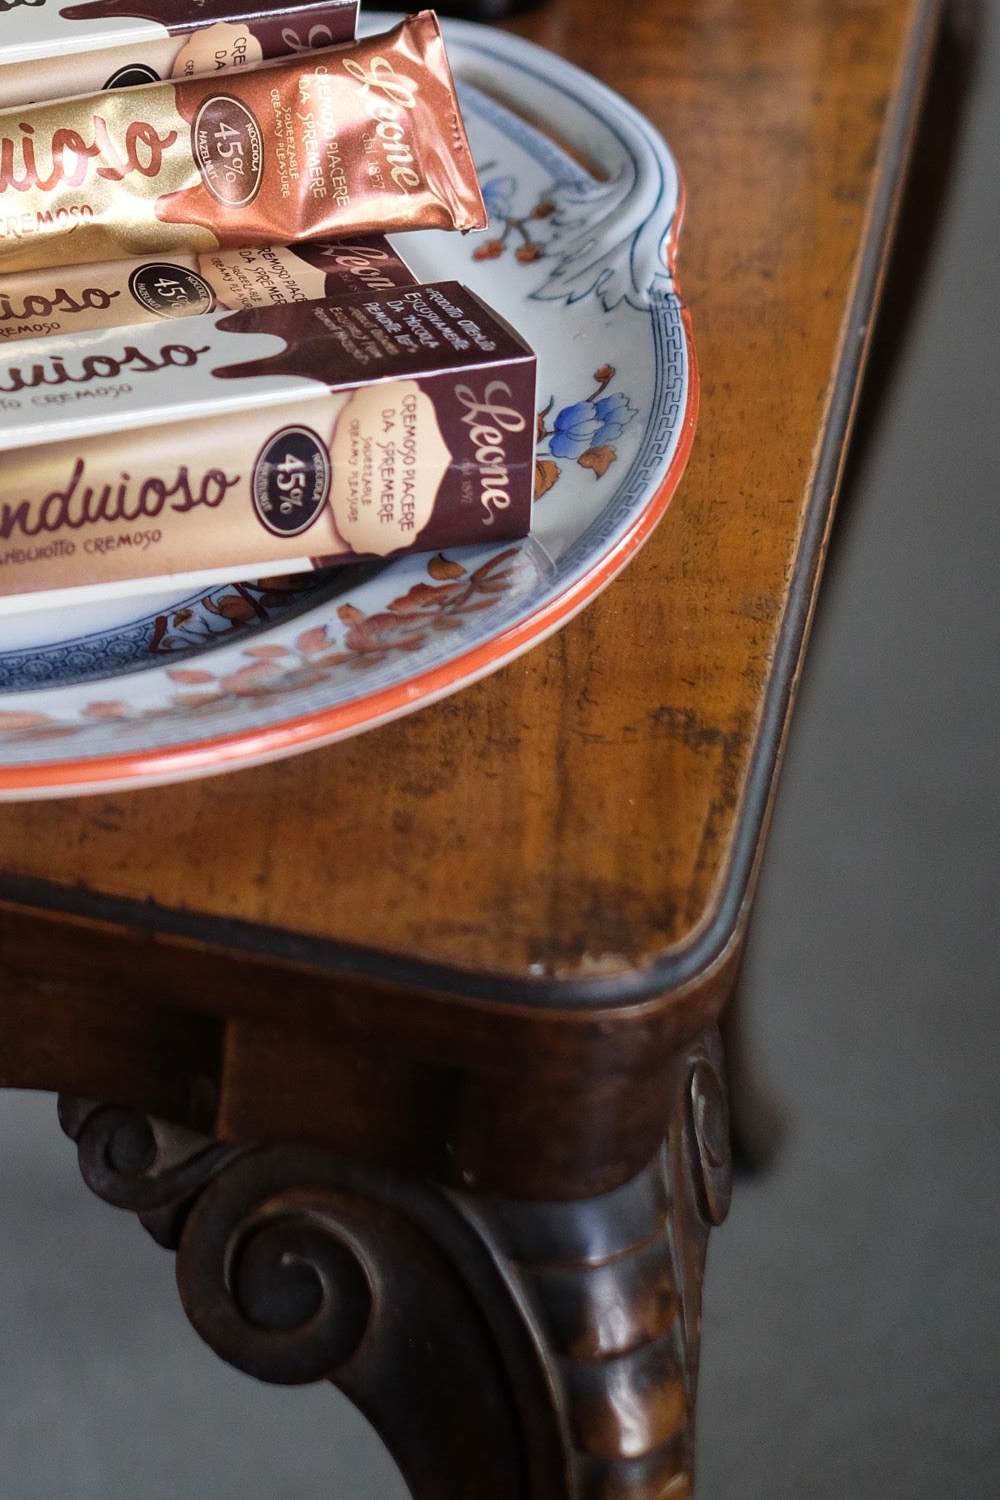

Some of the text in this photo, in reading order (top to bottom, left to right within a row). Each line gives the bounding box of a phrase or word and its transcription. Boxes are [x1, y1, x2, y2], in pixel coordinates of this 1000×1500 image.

[215, 50, 227, 70] DA
[298, 79, 312, 105] DA
[199, 131, 218, 180] HAZELNUT
[214, 121, 245, 183] 45%
[245, 122, 258, 171] NOCCIOLA
[270, 88, 290, 198] CREAMY PLEASURE
[282, 105, 300, 180] SQUEEZABLE
[296, 112, 327, 199] SPREMERE
[314, 65, 350, 207] CREMOSO PIACERE
[341, 56, 421, 200] Leone
[211, 257, 253, 309] CREAMY PLEASUR
[239, 250, 288, 305] DA SPREMER
[256, 244, 291, 280] REMOSO
[314, 240, 396, 290] Leon
[154, 277, 191, 309] 45%
[386, 300, 405, 313] DA
[404, 292, 470, 351] ESCLUSIVAMENTE
[33, 383, 133, 407] CREMOSO
[346, 419, 361, 523] CREAMY PLEASURE
[360, 435, 374, 506] SQUEEZABLE
[376, 409, 395, 524] DA SPREMERE
[397, 394, 417, 532] CREMOSO PIACERE
[454, 380, 527, 526] Leone
[276, 453, 305, 515] 45%
[83, 529, 162, 555] CREMOSO
